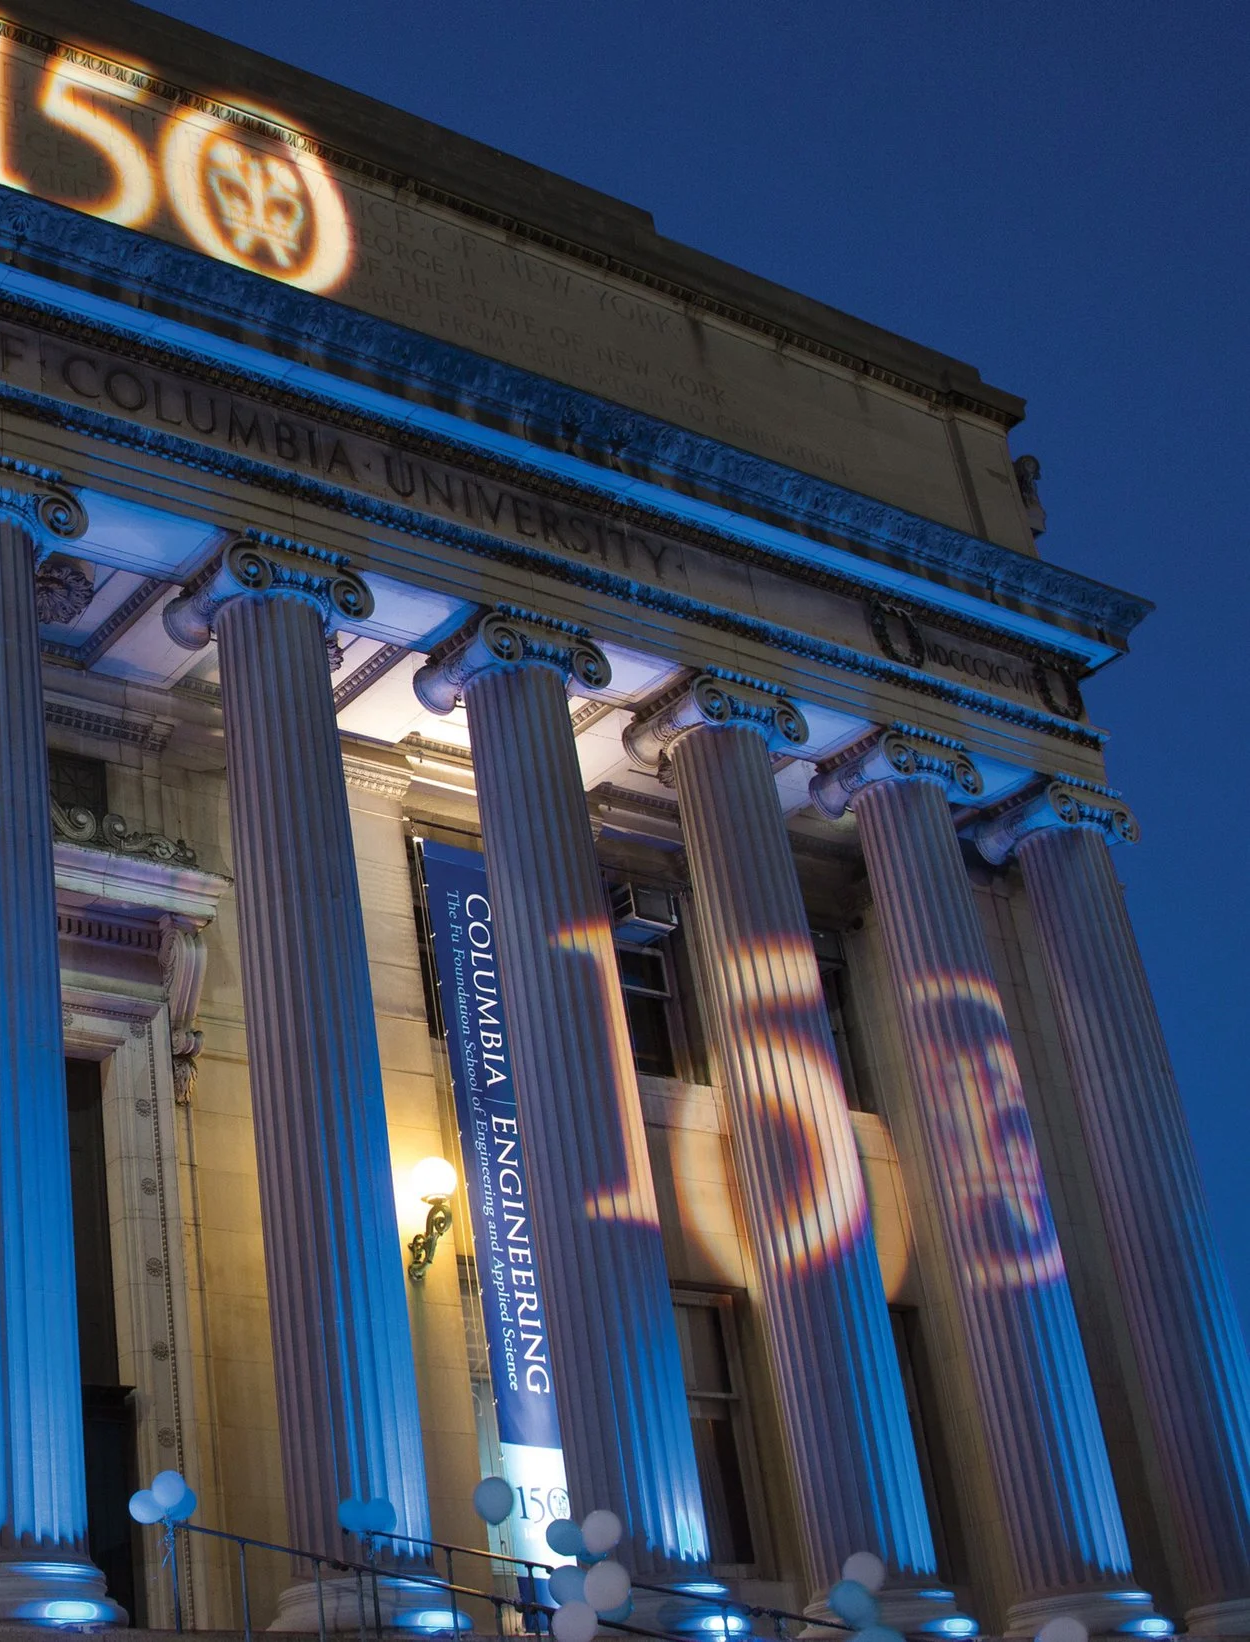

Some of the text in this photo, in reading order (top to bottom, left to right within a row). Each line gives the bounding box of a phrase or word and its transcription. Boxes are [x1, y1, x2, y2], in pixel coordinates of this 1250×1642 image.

[392, 264, 450, 305] THE
[461, 293, 539, 337] STATE
[550, 325, 586, 354] OF
[596, 346, 650, 378] NEW
[661, 366, 728, 407] YORK
[432, 226, 478, 259] OF
[499, 249, 572, 297] NEW
[590, 284, 671, 334] YORK
[437, 310, 507, 350] FROM
[519, 342, 666, 409] GENERATION
[674, 397, 705, 423] TO
[60, 355, 356, 480] COLUMBIA
[382, 451, 670, 578] UNIVERSITY
[446, 889, 519, 1392] The Fu Foundation School of Engineering and Applied Science
[465, 893, 551, 1395] COLUMBIA ENGINEERING
[516, 1486, 571, 1524] 150
